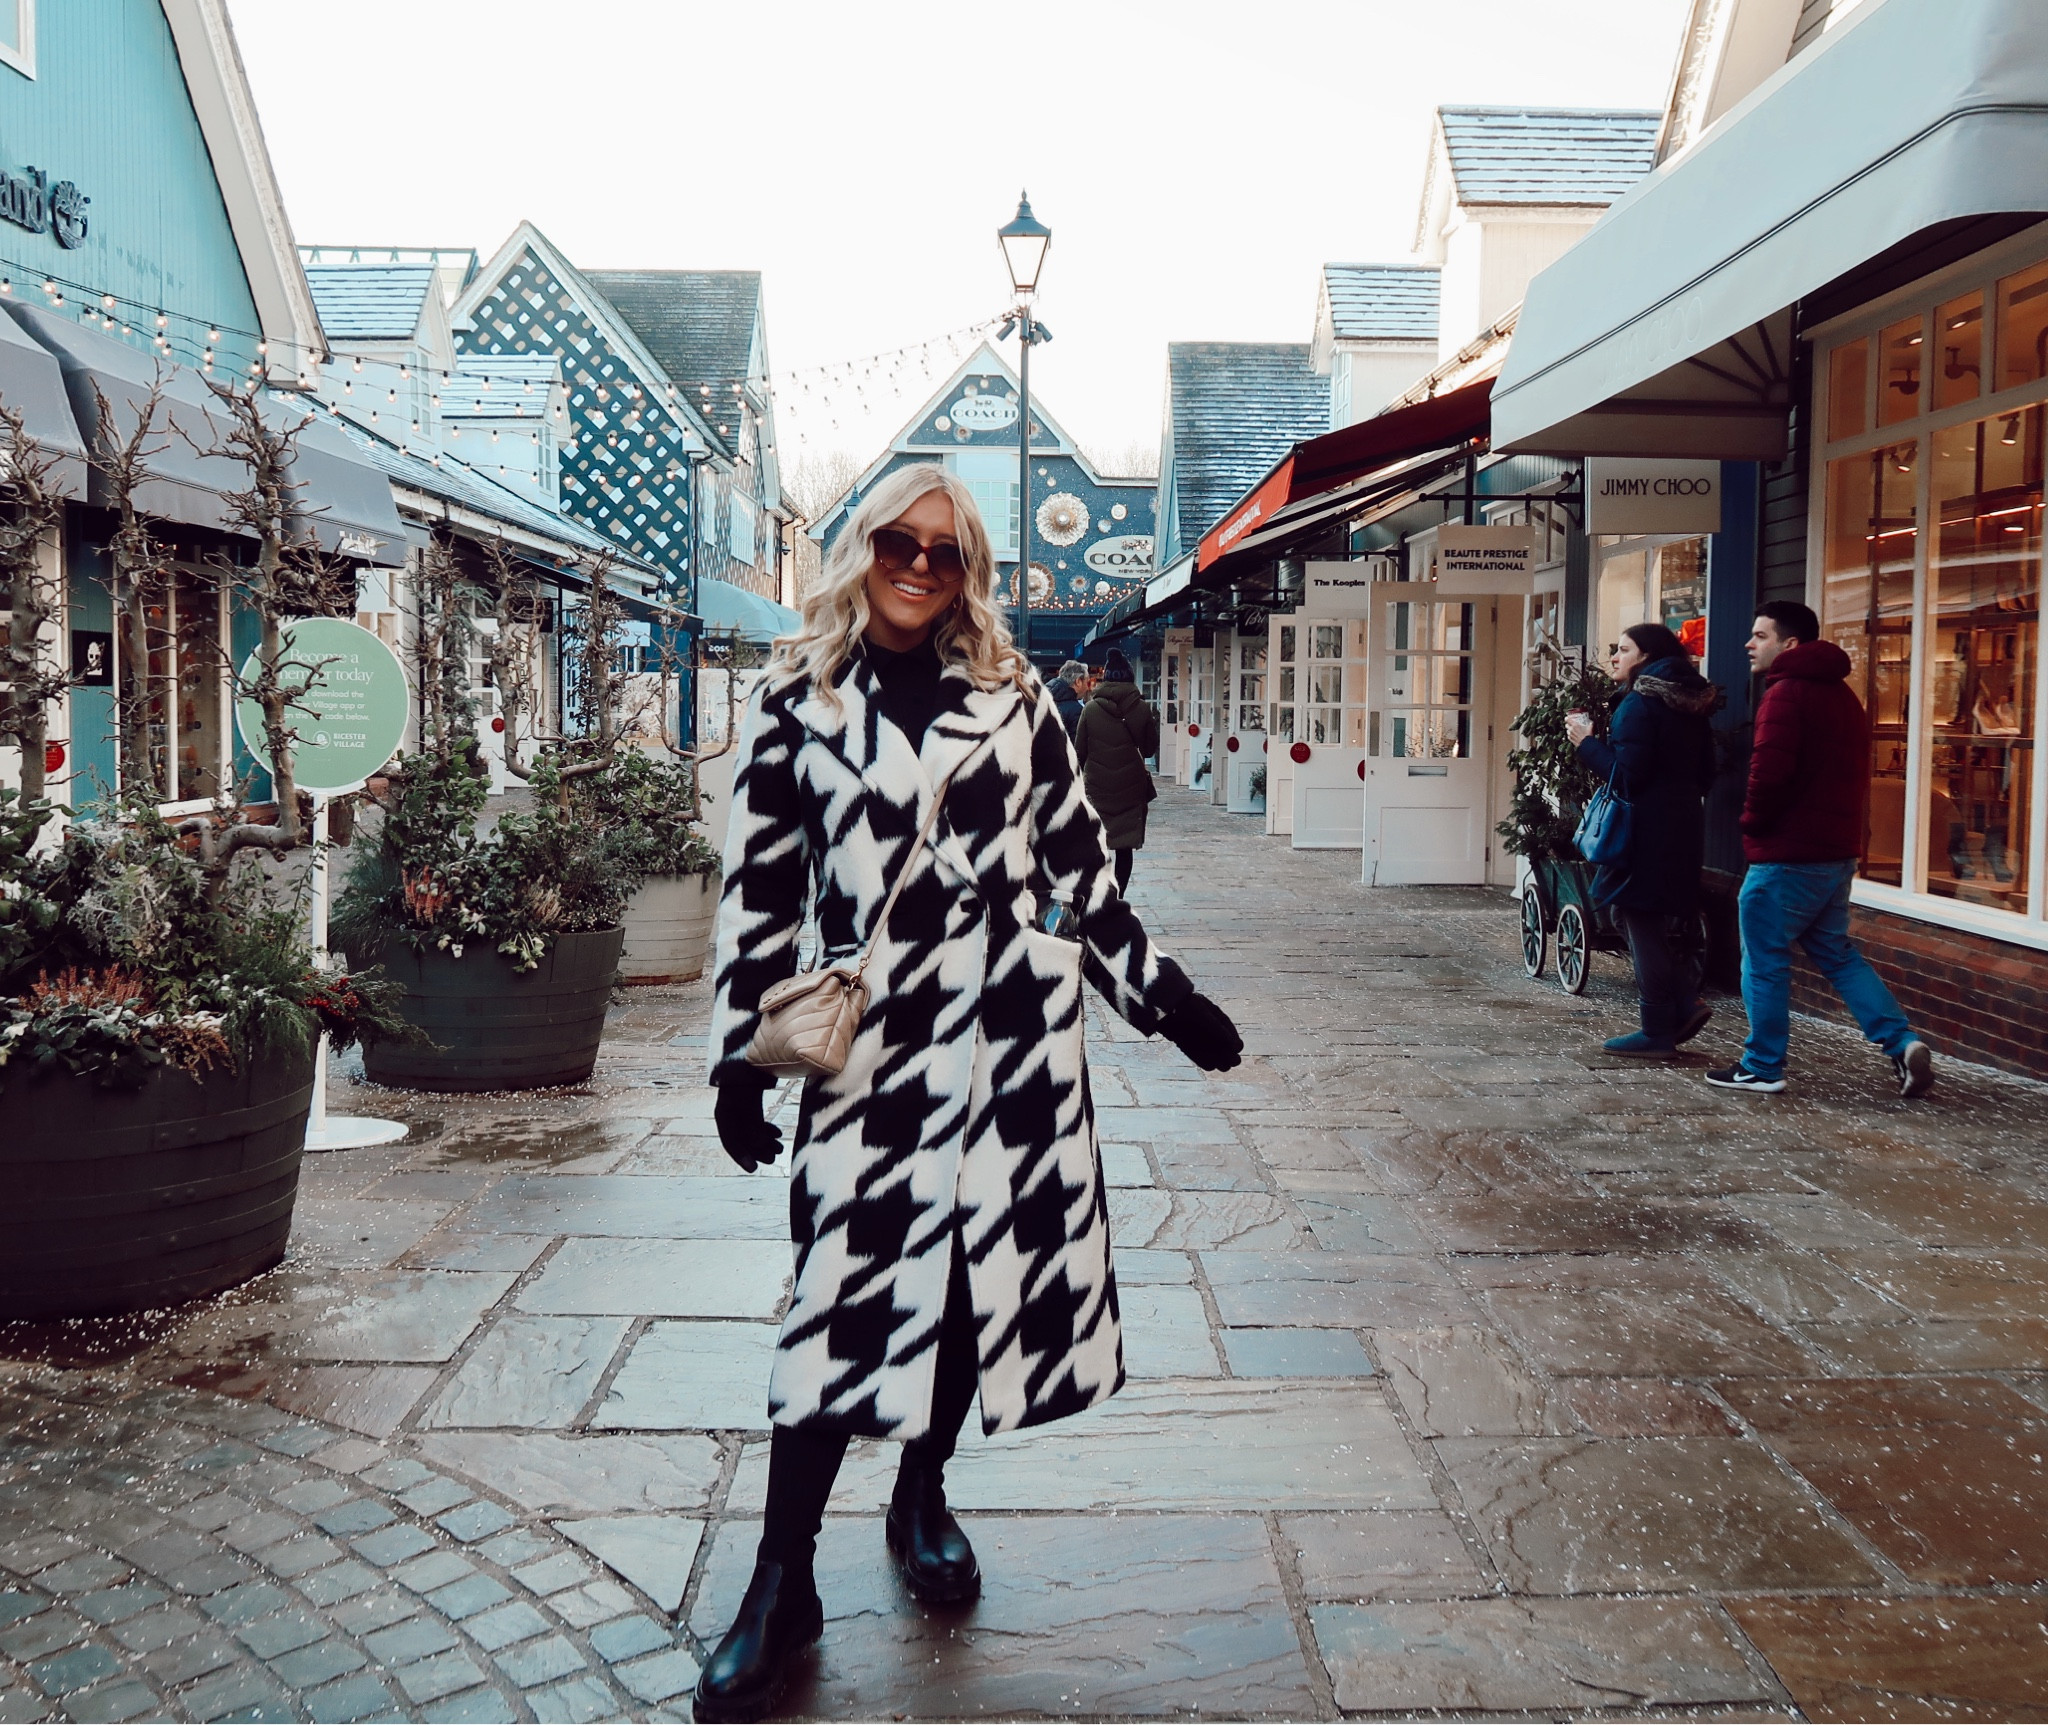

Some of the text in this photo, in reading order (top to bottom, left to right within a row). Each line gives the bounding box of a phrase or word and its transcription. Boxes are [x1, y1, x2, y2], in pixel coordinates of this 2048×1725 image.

[952, 408, 1016, 418] COACH
[1600, 477, 1711, 496] JIMMY CHOO
[1444, 549, 1529, 559] BEAUTE PRESTIGE
[1446, 561, 1526, 571] INTERNATIONAL
[1313, 579, 1366, 588] The Kooples
[290, 648, 359, 664] Become a
[335, 667, 374, 685] today
[311, 690, 350, 698] download
[351, 690, 365, 698] the
[312, 701, 338, 711] Village
[340, 703, 356, 711] app
[296, 712, 308, 720] the
[324, 713, 344, 721] code
